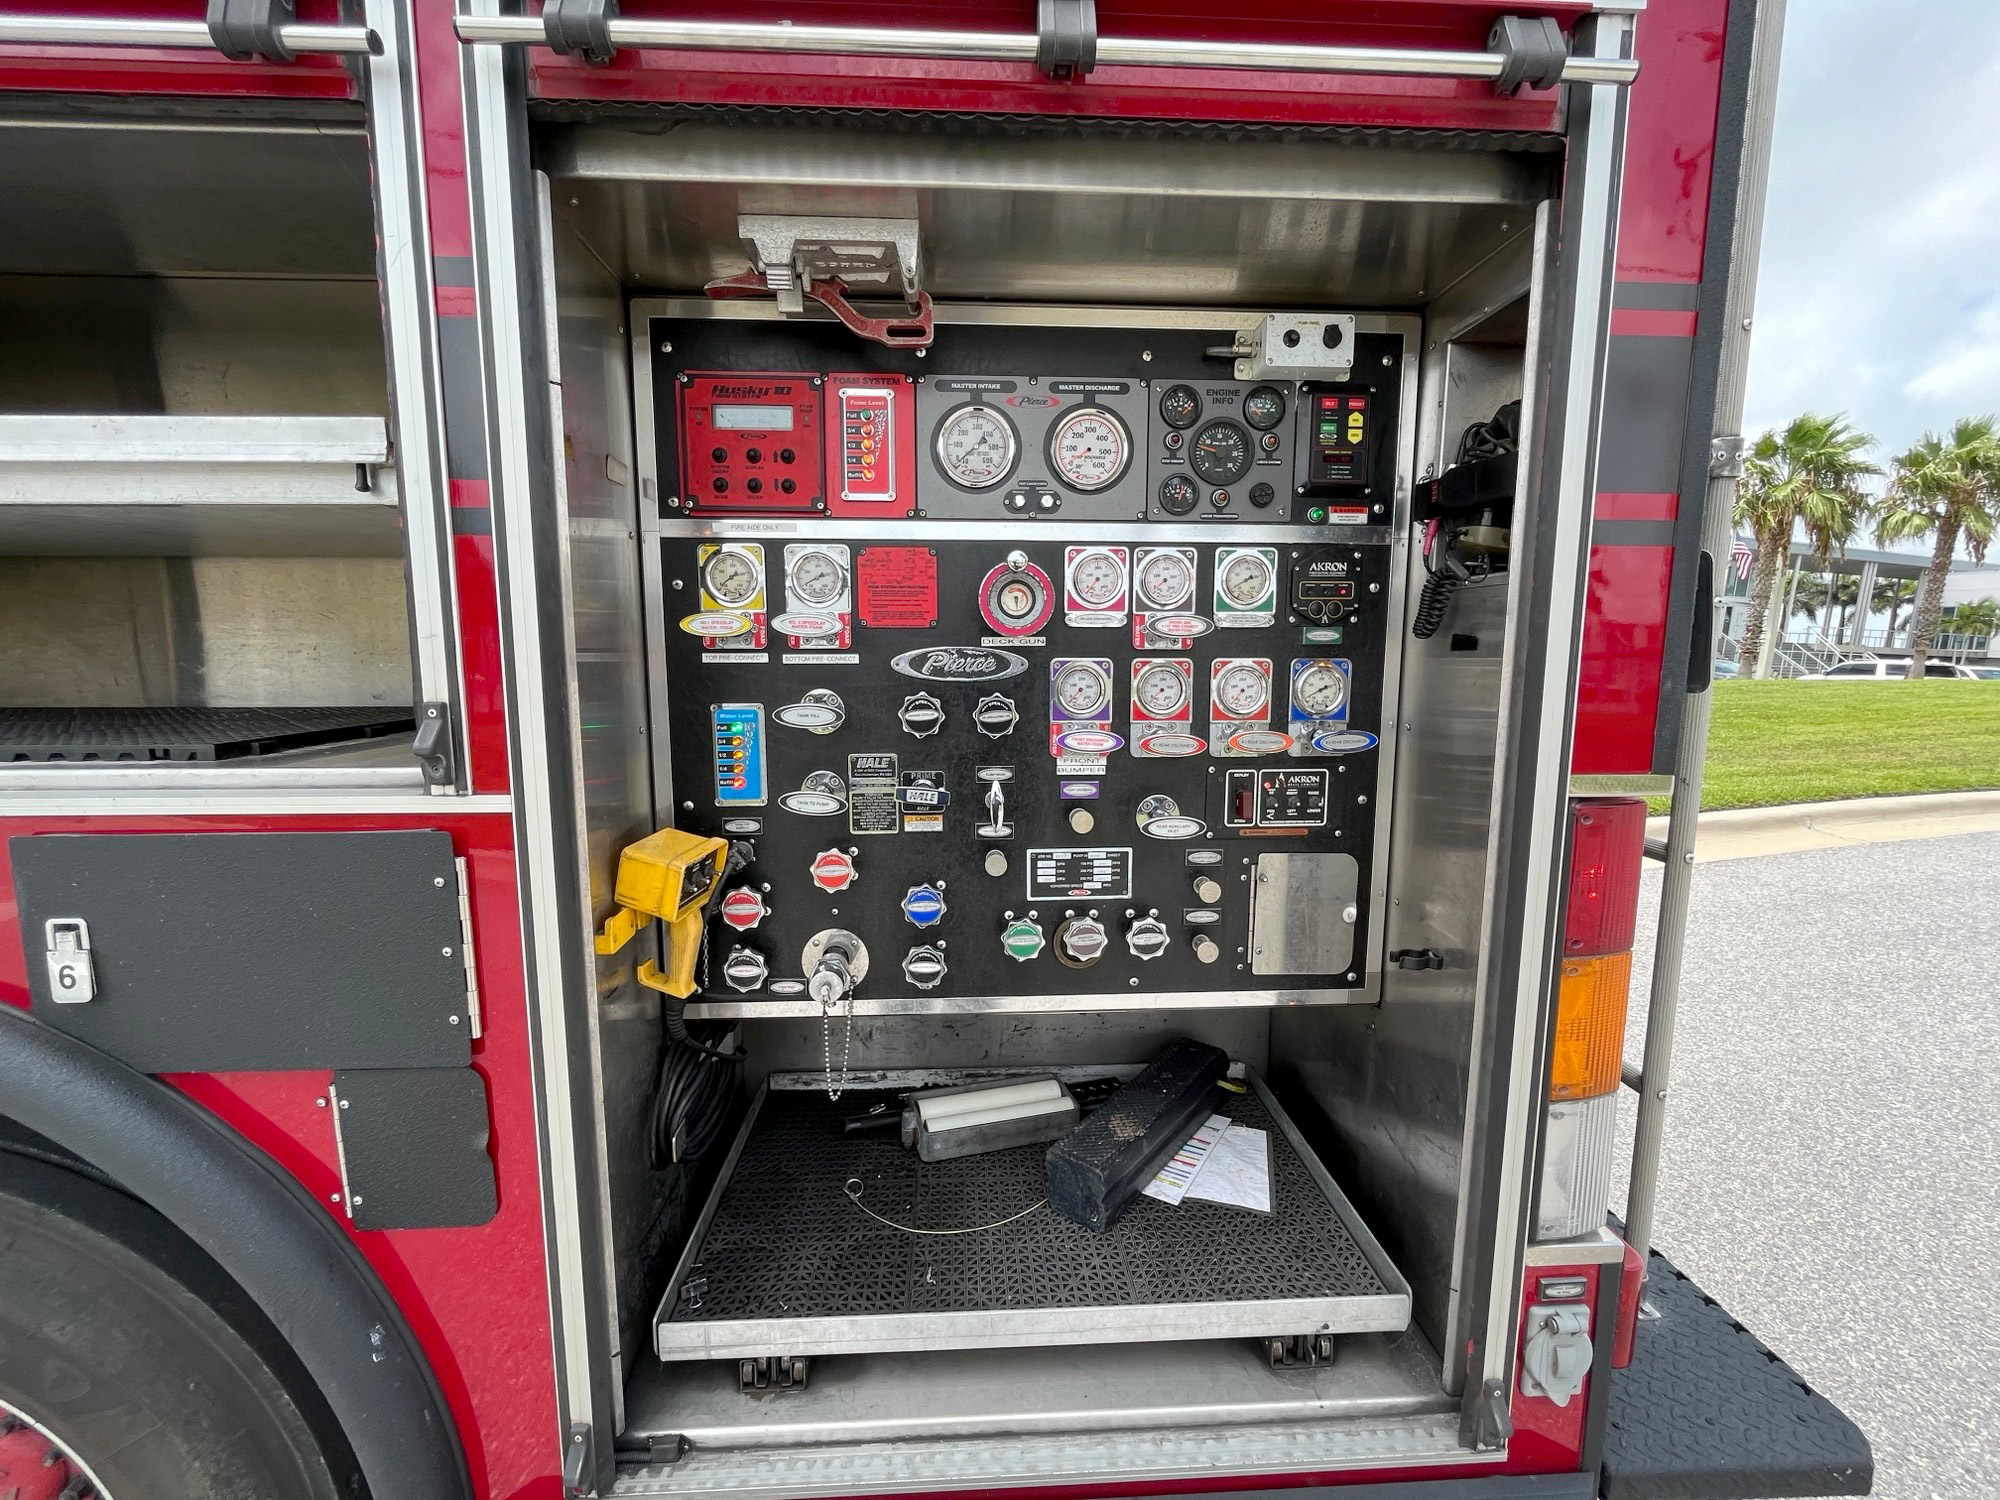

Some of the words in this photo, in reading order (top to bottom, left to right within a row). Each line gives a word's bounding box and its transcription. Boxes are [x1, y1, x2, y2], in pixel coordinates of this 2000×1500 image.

[711, 385, 770, 396] Husky
[1019, 396, 1049, 406] Pierce
[1309, 562, 1347, 571] AKRON
[922, 651, 996, 675] Pierce
[856, 758, 890, 768] HALE
[909, 792, 936, 802] HALE
[59, 964, 76, 990] 6
